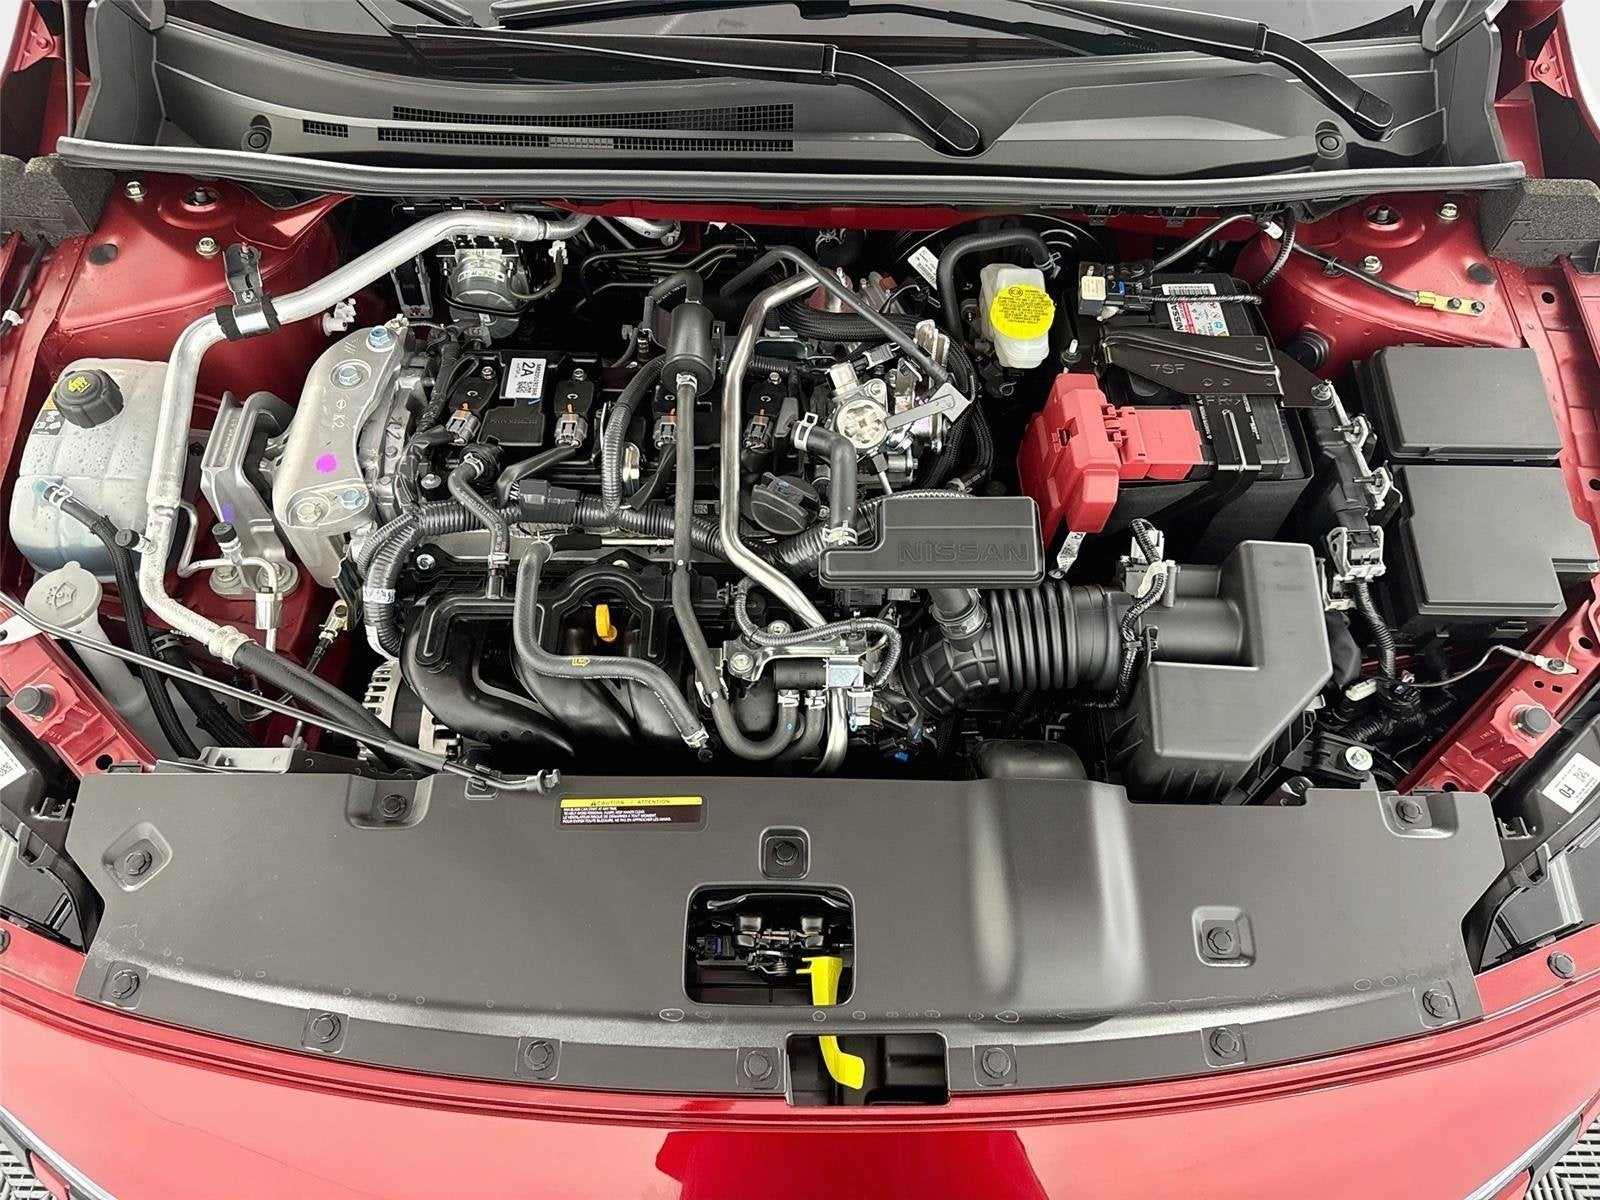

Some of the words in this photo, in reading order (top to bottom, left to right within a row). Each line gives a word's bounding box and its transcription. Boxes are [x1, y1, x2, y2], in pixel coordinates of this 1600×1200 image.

[1170, 302, 1185, 331] NISSA
[520, 361, 536, 377] 2A
[1149, 363, 1186, 376] 7SF
[897, 543, 1029, 563] NISSAN
